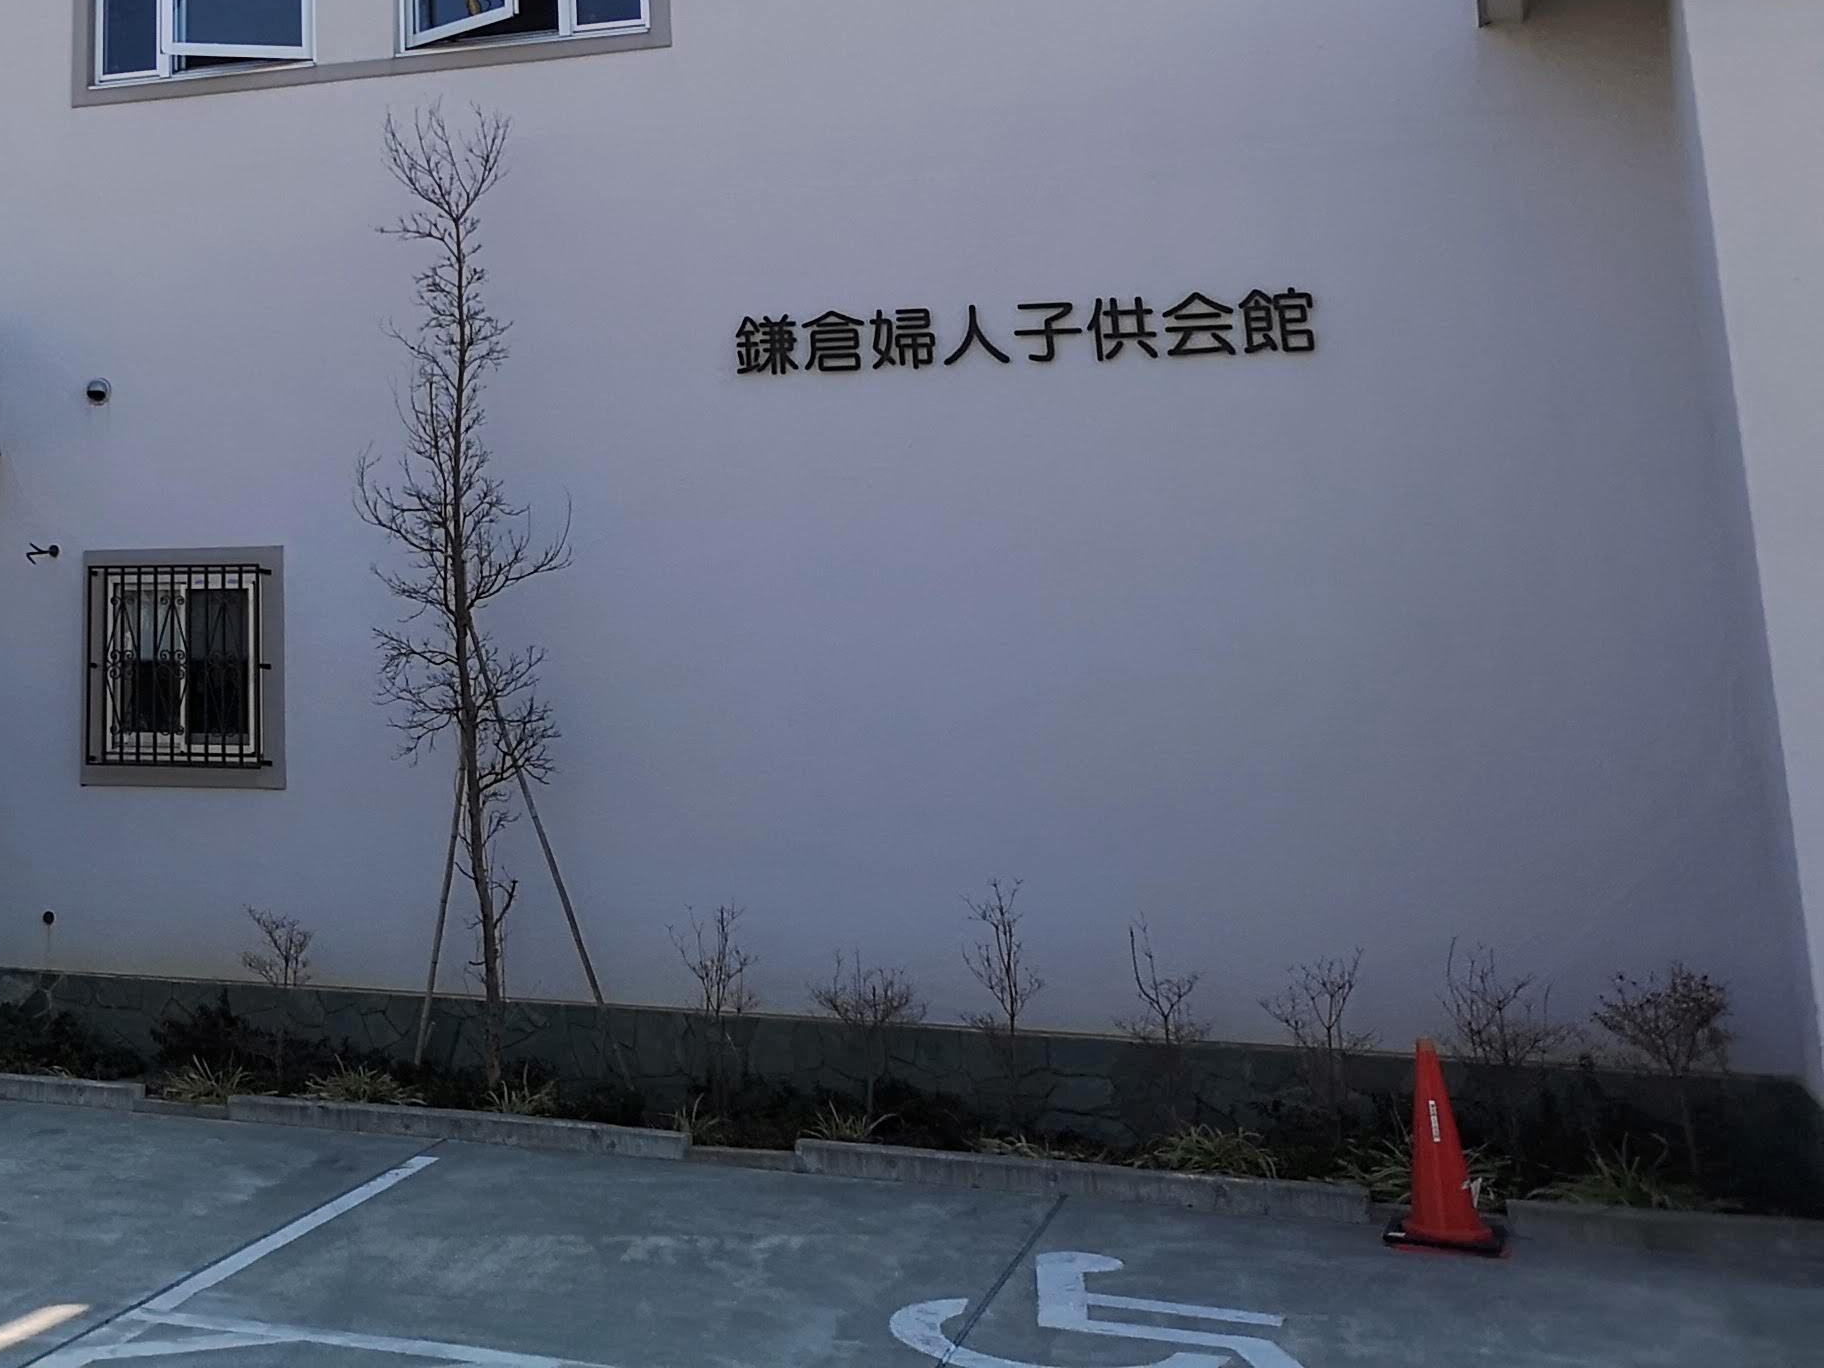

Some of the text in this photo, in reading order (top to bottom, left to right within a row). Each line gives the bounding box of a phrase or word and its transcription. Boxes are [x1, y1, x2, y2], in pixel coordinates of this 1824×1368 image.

[736, 286, 1316, 375] 鎌倉婦人子供会館
